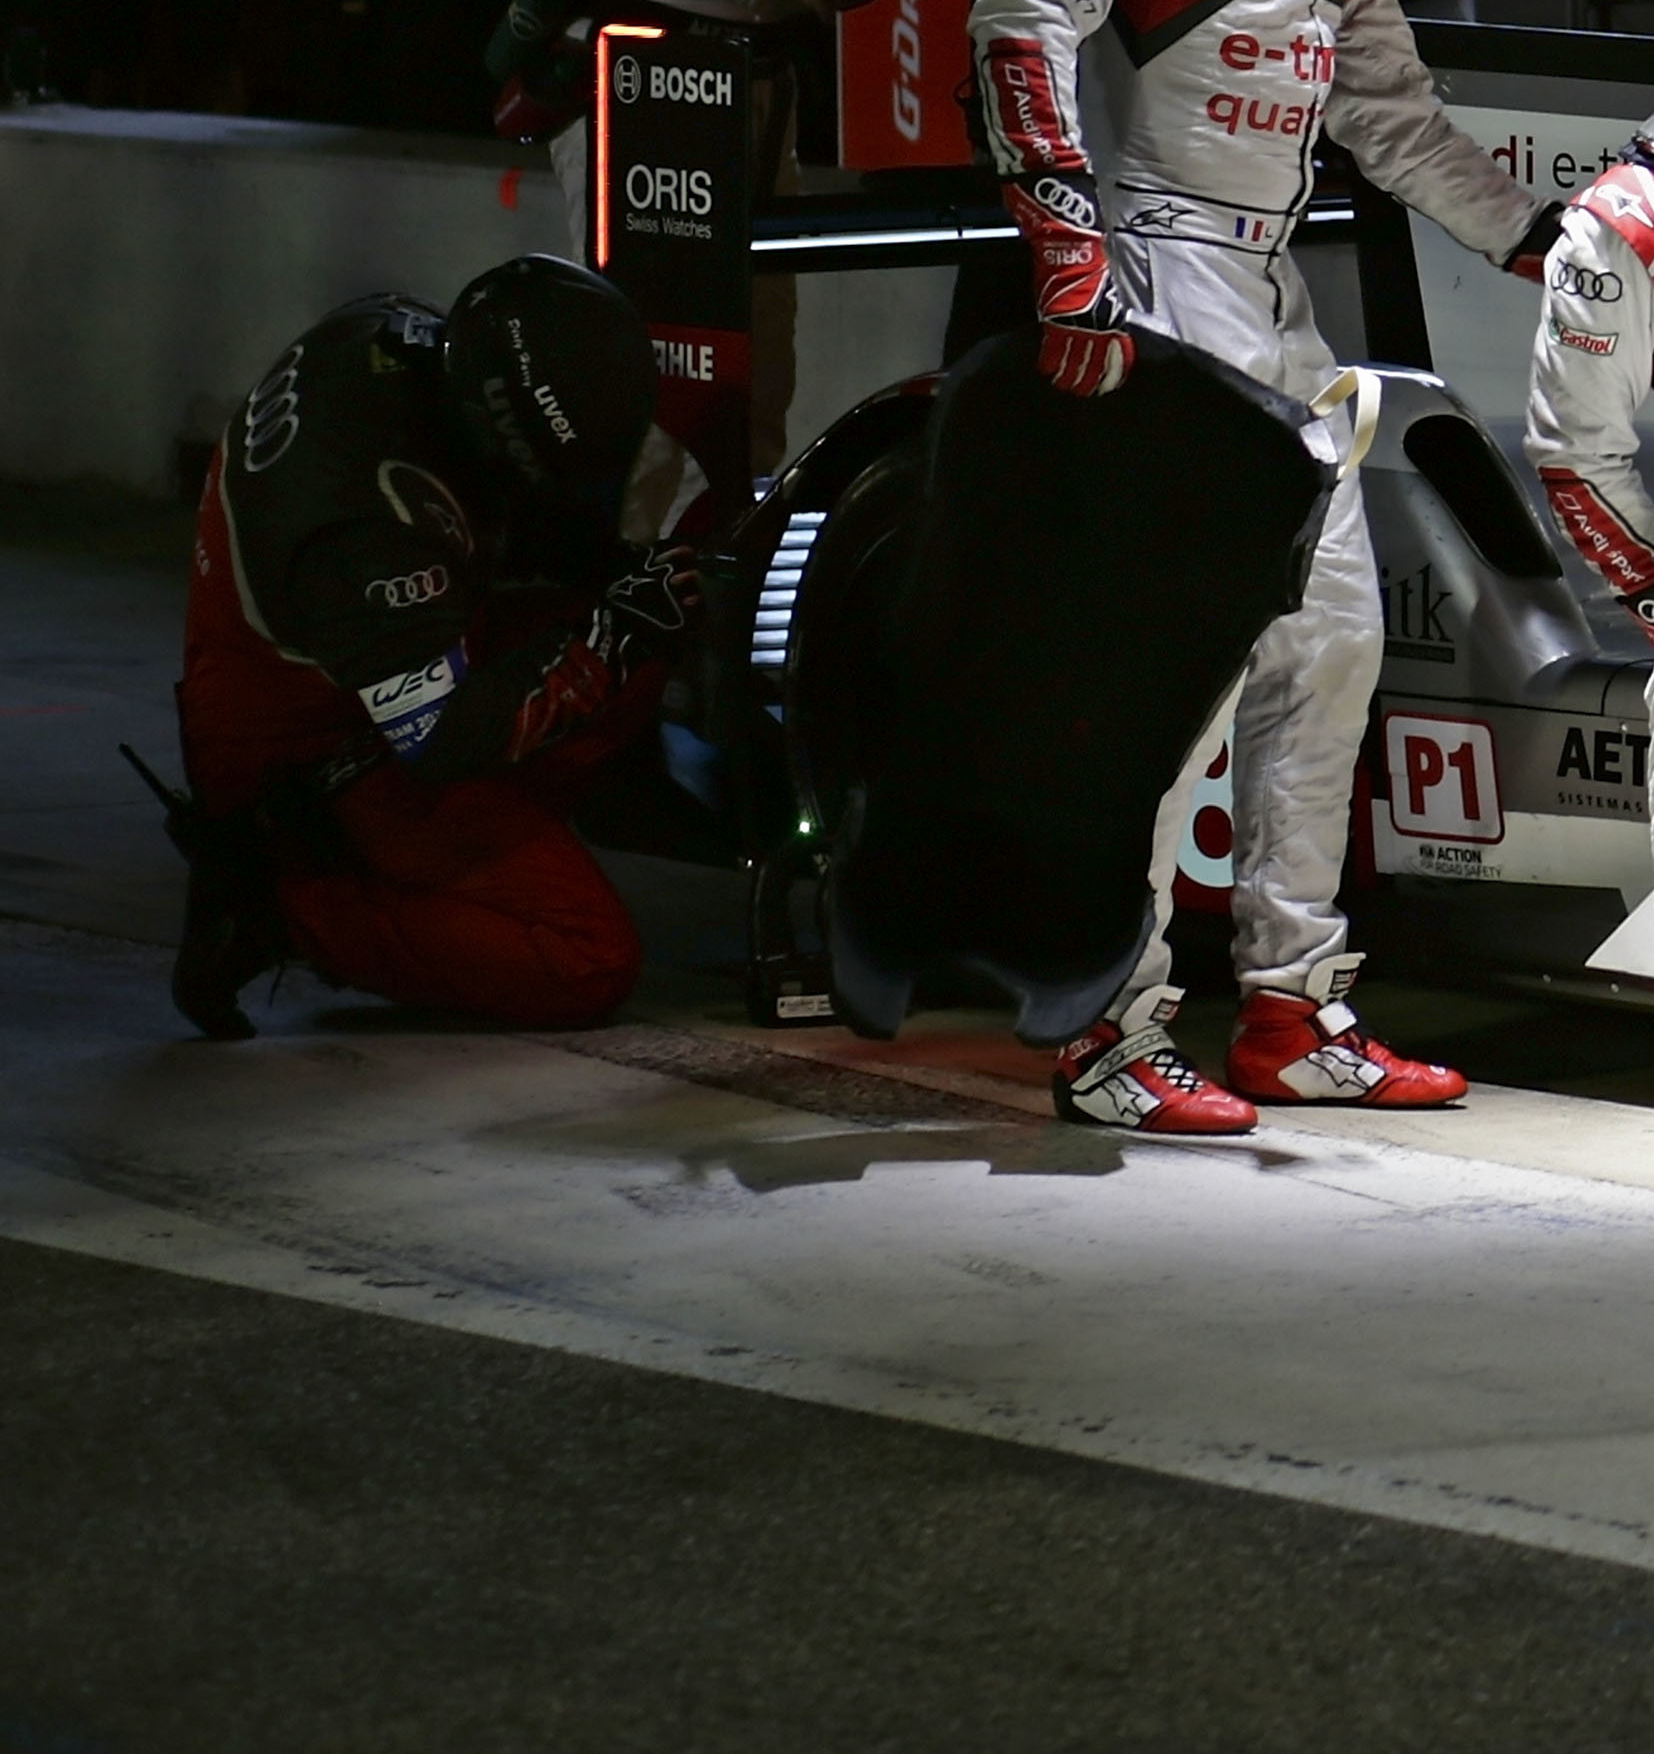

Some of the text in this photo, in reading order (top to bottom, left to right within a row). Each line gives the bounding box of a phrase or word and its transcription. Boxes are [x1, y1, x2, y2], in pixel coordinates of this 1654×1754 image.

[650, 65, 733, 107] BOSCH
[625, 162, 713, 216] ORIS
[1553, 147, 1619, 189] e-t
[625, 211, 713, 241] Swiss Watches
[651, 338, 714, 382] AHLE
[1559, 328, 1611, 354] Castrol
[533, 383, 578, 446] uvex
[1573, 512, 1611, 553] Audi
[1382, 567, 1455, 644] itk
[371, 658, 446, 709] WEC
[1556, 726, 1649, 787] AET
[1404, 734, 1484, 823] P1
[1557, 792, 1643, 813] SISTEMAS
[1437, 847, 1483, 864] ACTION
